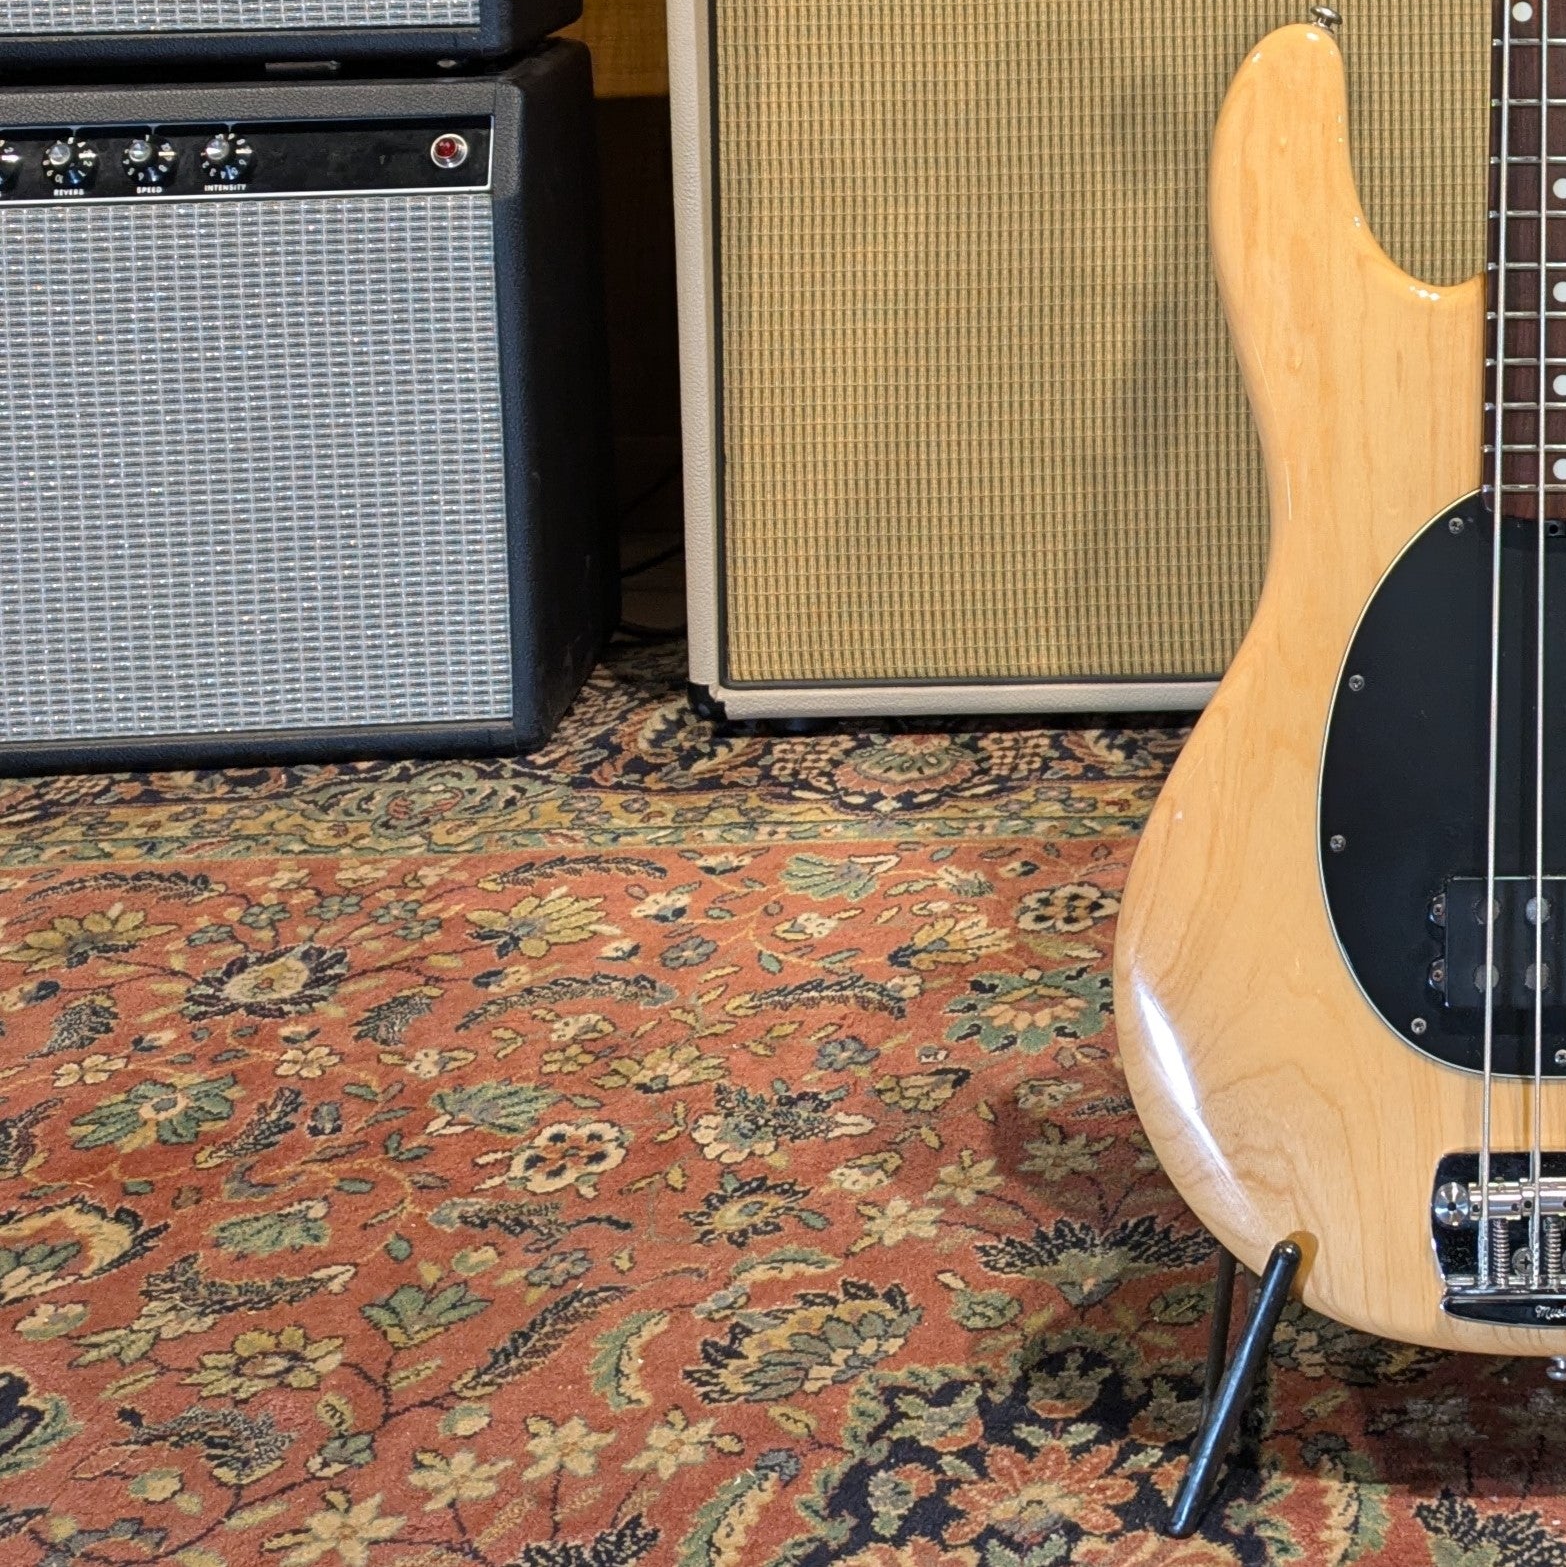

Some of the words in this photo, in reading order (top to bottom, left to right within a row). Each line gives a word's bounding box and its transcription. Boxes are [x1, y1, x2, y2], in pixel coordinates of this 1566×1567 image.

[136, 186, 163, 194] SPEED
[204, 184, 247, 192] INTENSITY
[53, 188, 85, 197] REVERB
